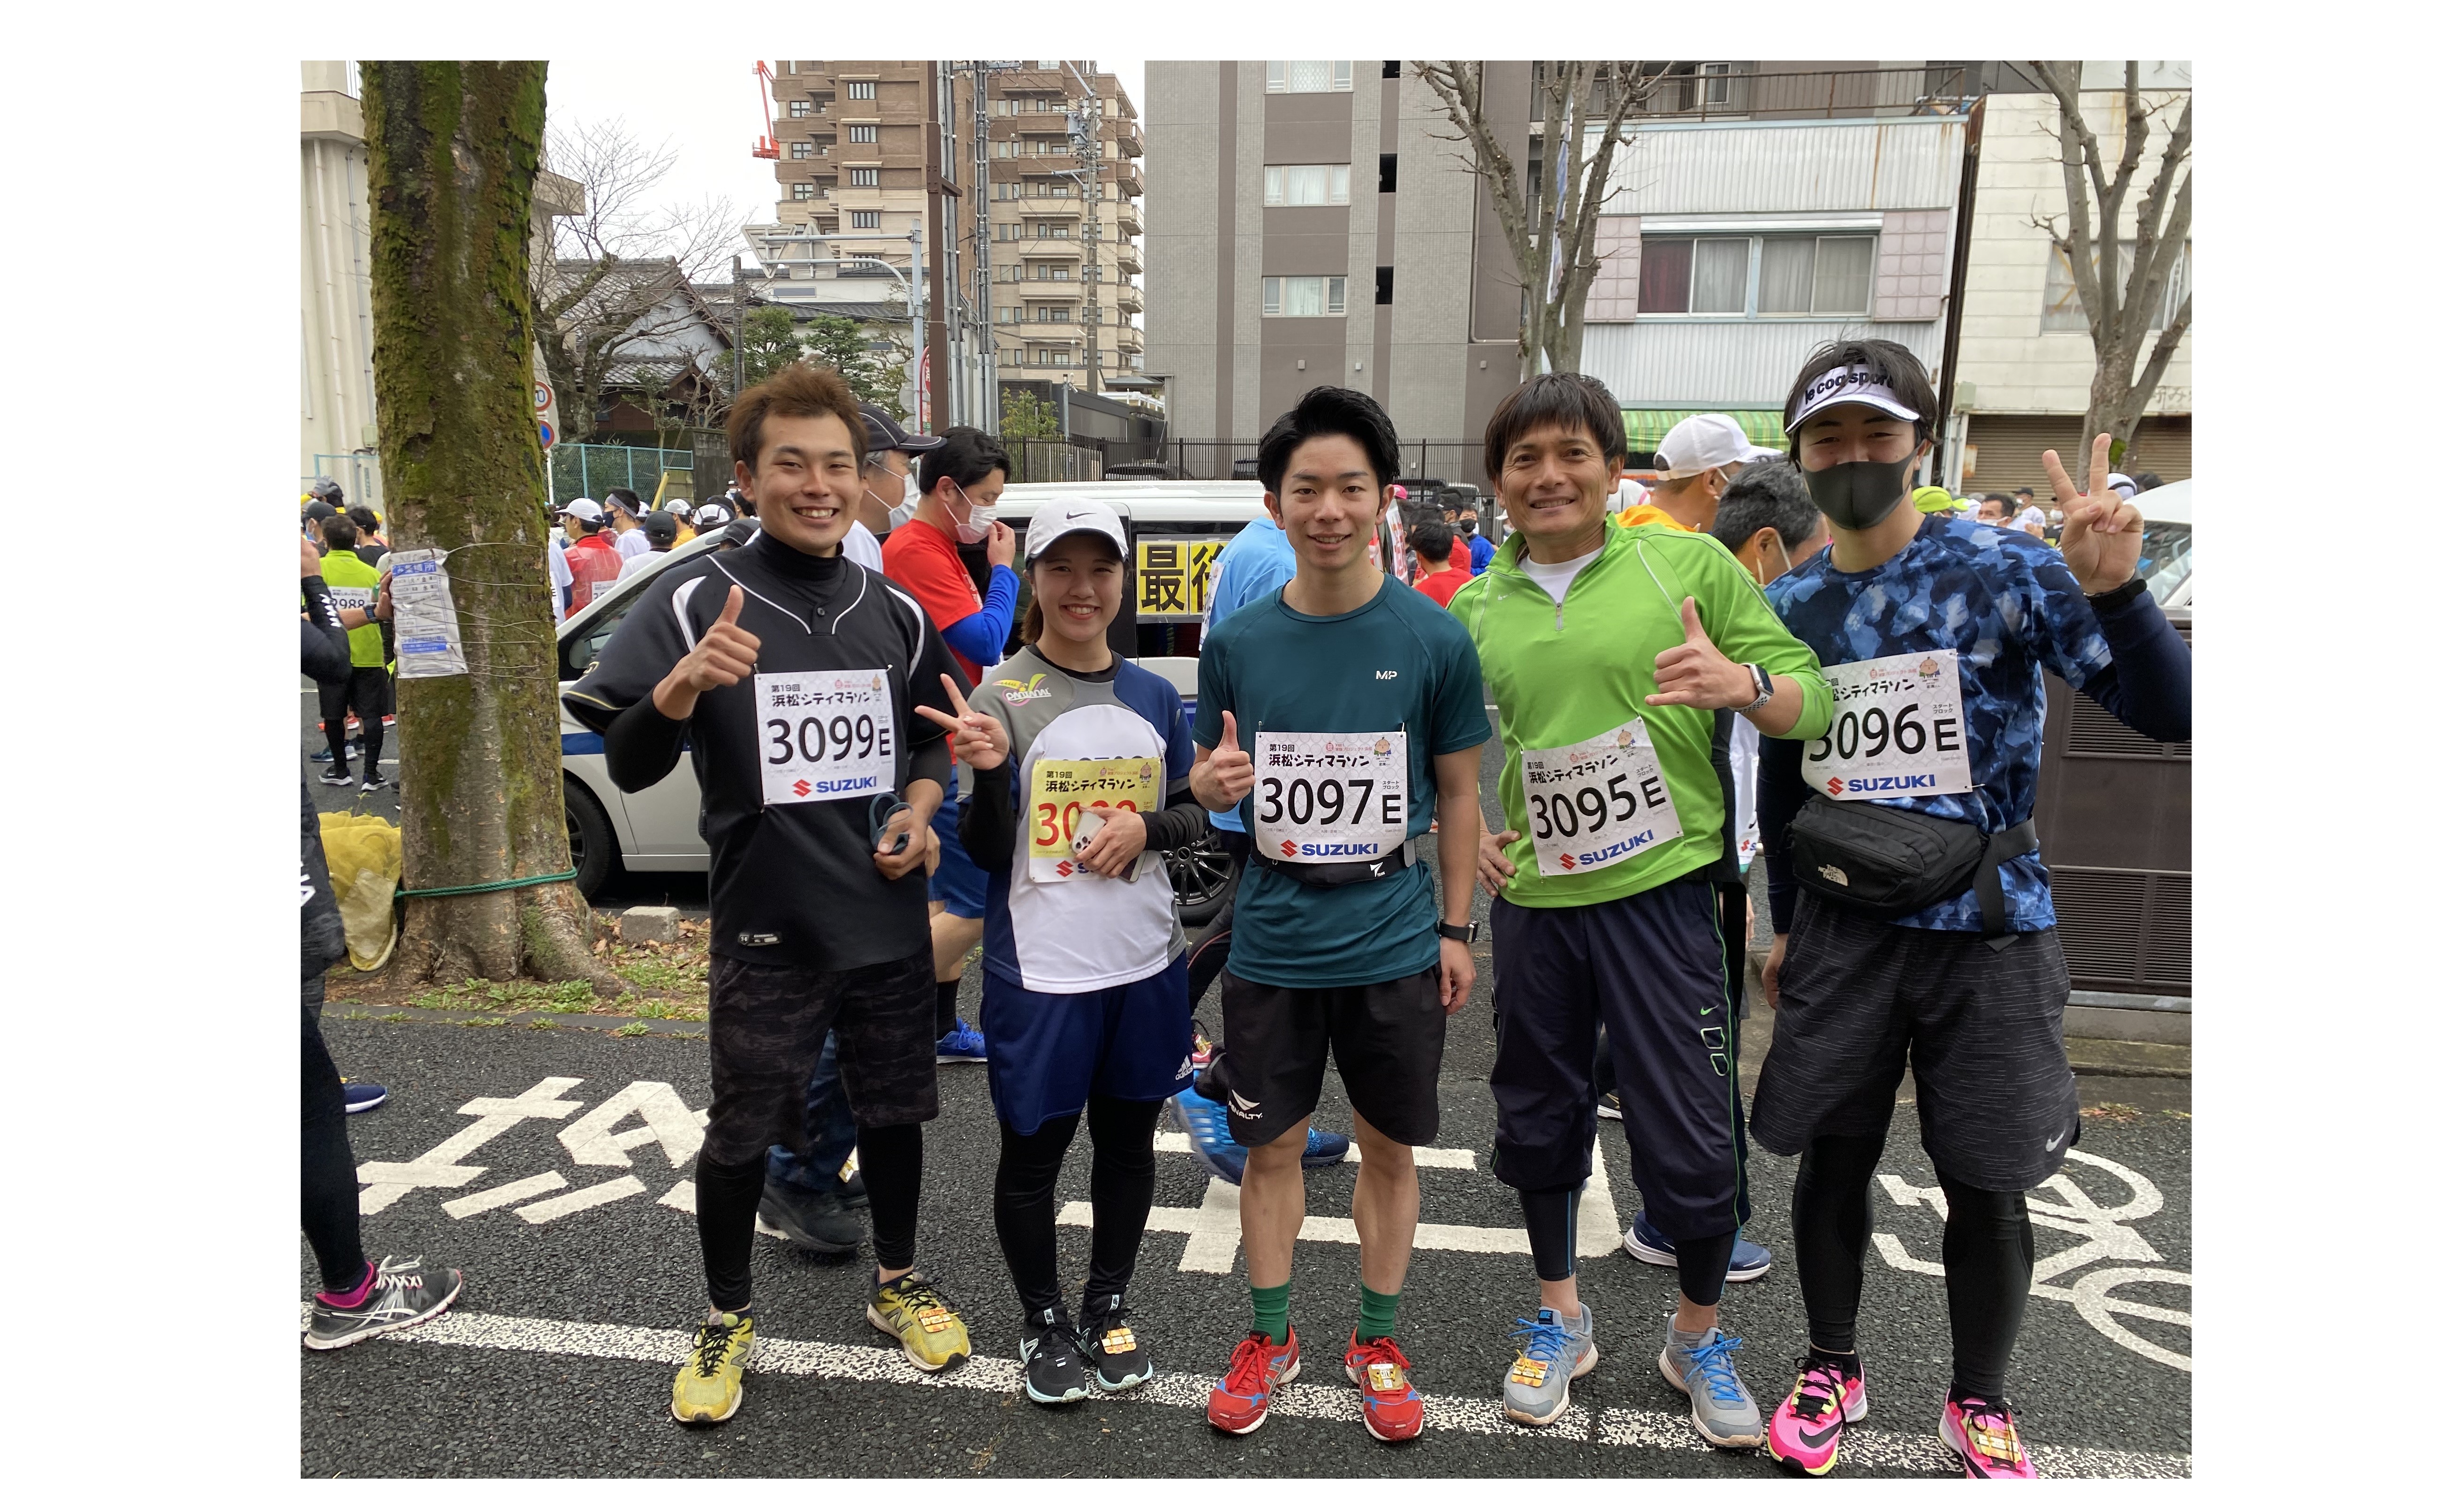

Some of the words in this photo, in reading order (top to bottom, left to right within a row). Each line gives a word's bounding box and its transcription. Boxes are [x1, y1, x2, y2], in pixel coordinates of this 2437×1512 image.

[535, 390, 546, 403] 0
[1376, 670, 1397, 680] MP
[771, 684, 800, 692] 第19回
[1833, 679, 1915, 702] シティマラソン
[772, 692, 869, 707] 浜松シティマラソン
[767, 714, 873, 765] 3099
[879, 728, 891, 757] E
[1934, 718, 1959, 752] E
[1269, 744, 1295, 752] 第19回
[1269, 754, 1369, 767] 浜松シティマラソン
[1529, 754, 1618, 784] 浜松シティマラソン
[1046, 770, 1072, 779] 第19回
[1848, 774, 1936, 792] SUZUKI
[816, 776, 877, 793] SUZUKI
[1046, 778, 1135, 793] 浜松シティマラソン
[1260, 777, 1374, 825] 3097
[1382, 794, 1401, 824] E
[1530, 773, 1637, 839] 3095
[1640, 775, 1666, 809] E
[1036, 800, 1136, 846] 30
[1301, 843, 1378, 856] SUZUKI
[1579, 829, 1654, 865] SUZUKI
[1229, 1100, 1263, 1120] PENALTY
